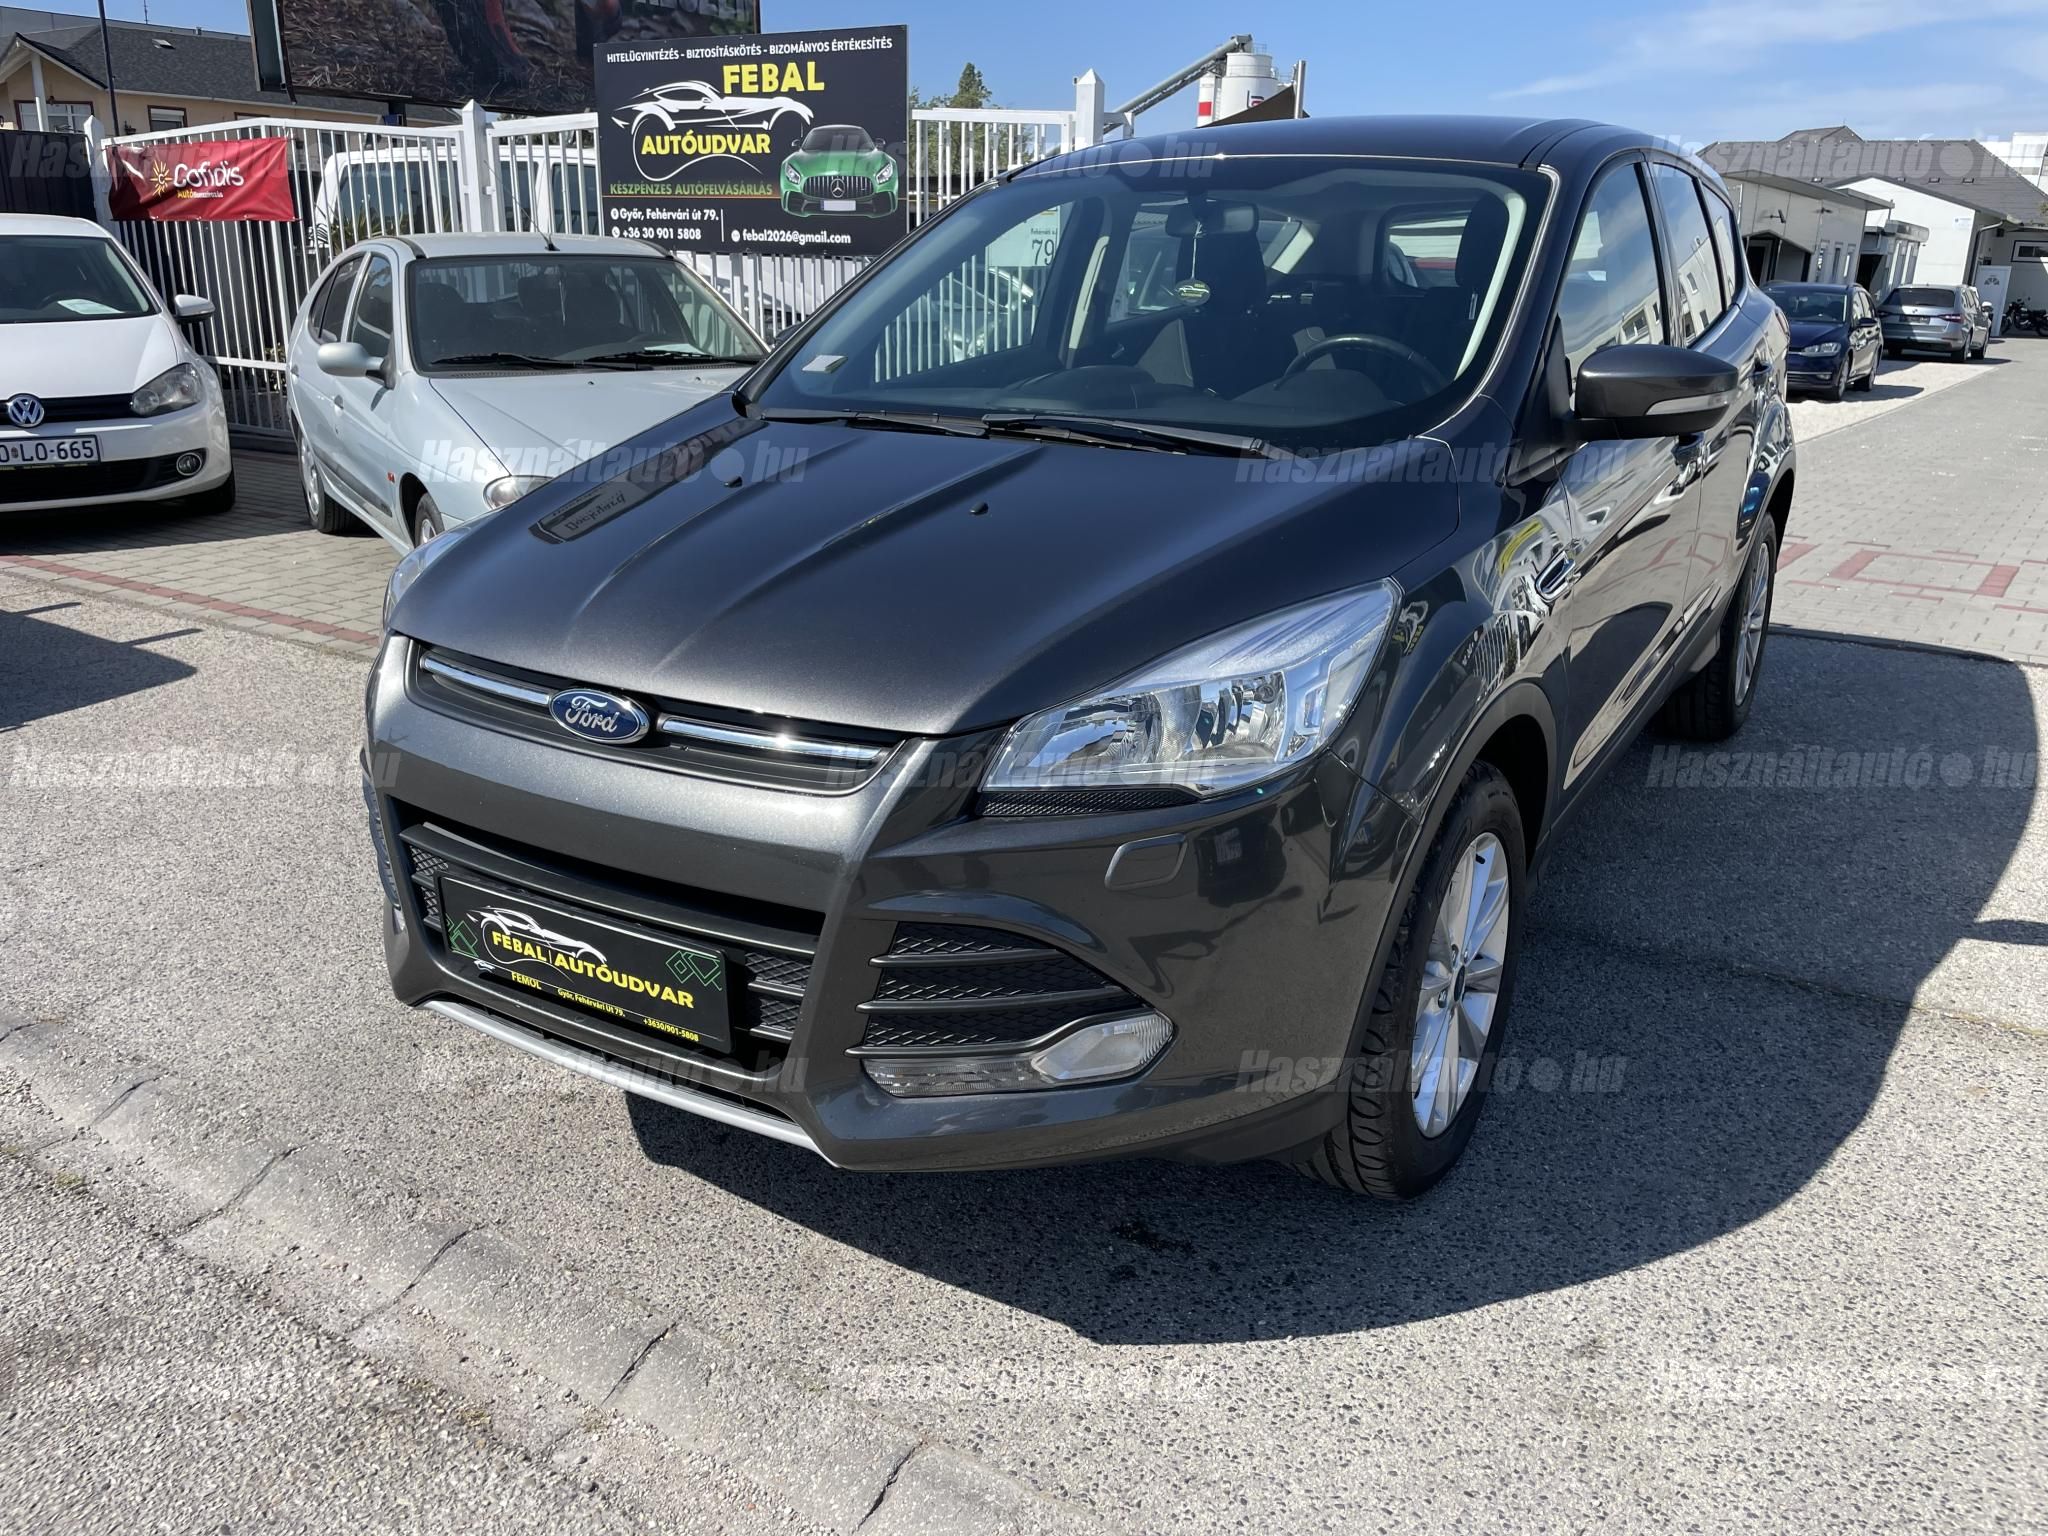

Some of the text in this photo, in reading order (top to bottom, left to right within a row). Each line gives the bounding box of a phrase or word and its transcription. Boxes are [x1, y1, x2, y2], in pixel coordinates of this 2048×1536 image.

[607, 48, 679, 63] HITELÜGYINTÉZÉS
[686, 43, 761, 59] BIZTOSÍTÁSKÖTÉS
[770, 41, 830, 55] BIZOMÁNYOS
[831, 36, 893, 51] ÉRTÉKESÍTÉS
[723, 61, 825, 94] FEBAL
[641, 129, 771, 155] AUTÓUDVAR
[173, 160, 245, 188] Cofidis
[610, 181, 773, 196] KÉSZPÉNZES AUTÓFELVÁSÁRLÁS
[646, 208, 690, 220] Fehérvári
[692, 209, 702, 220] út
[703, 209, 719, 221] 79.
[622, 227, 702, 240] +36 30 901 5808
[742, 229, 851, 246] febal2026@gmail.com
[1032, 238, 1055, 266] 79
[565, 695, 621, 733] Ford
[491, 930, 695, 1009] FEBAL AUTÓUDVAR
[511, 971, 542, 990] FEMOL
[643, 1018, 699, 1041] +3630/901-5808
